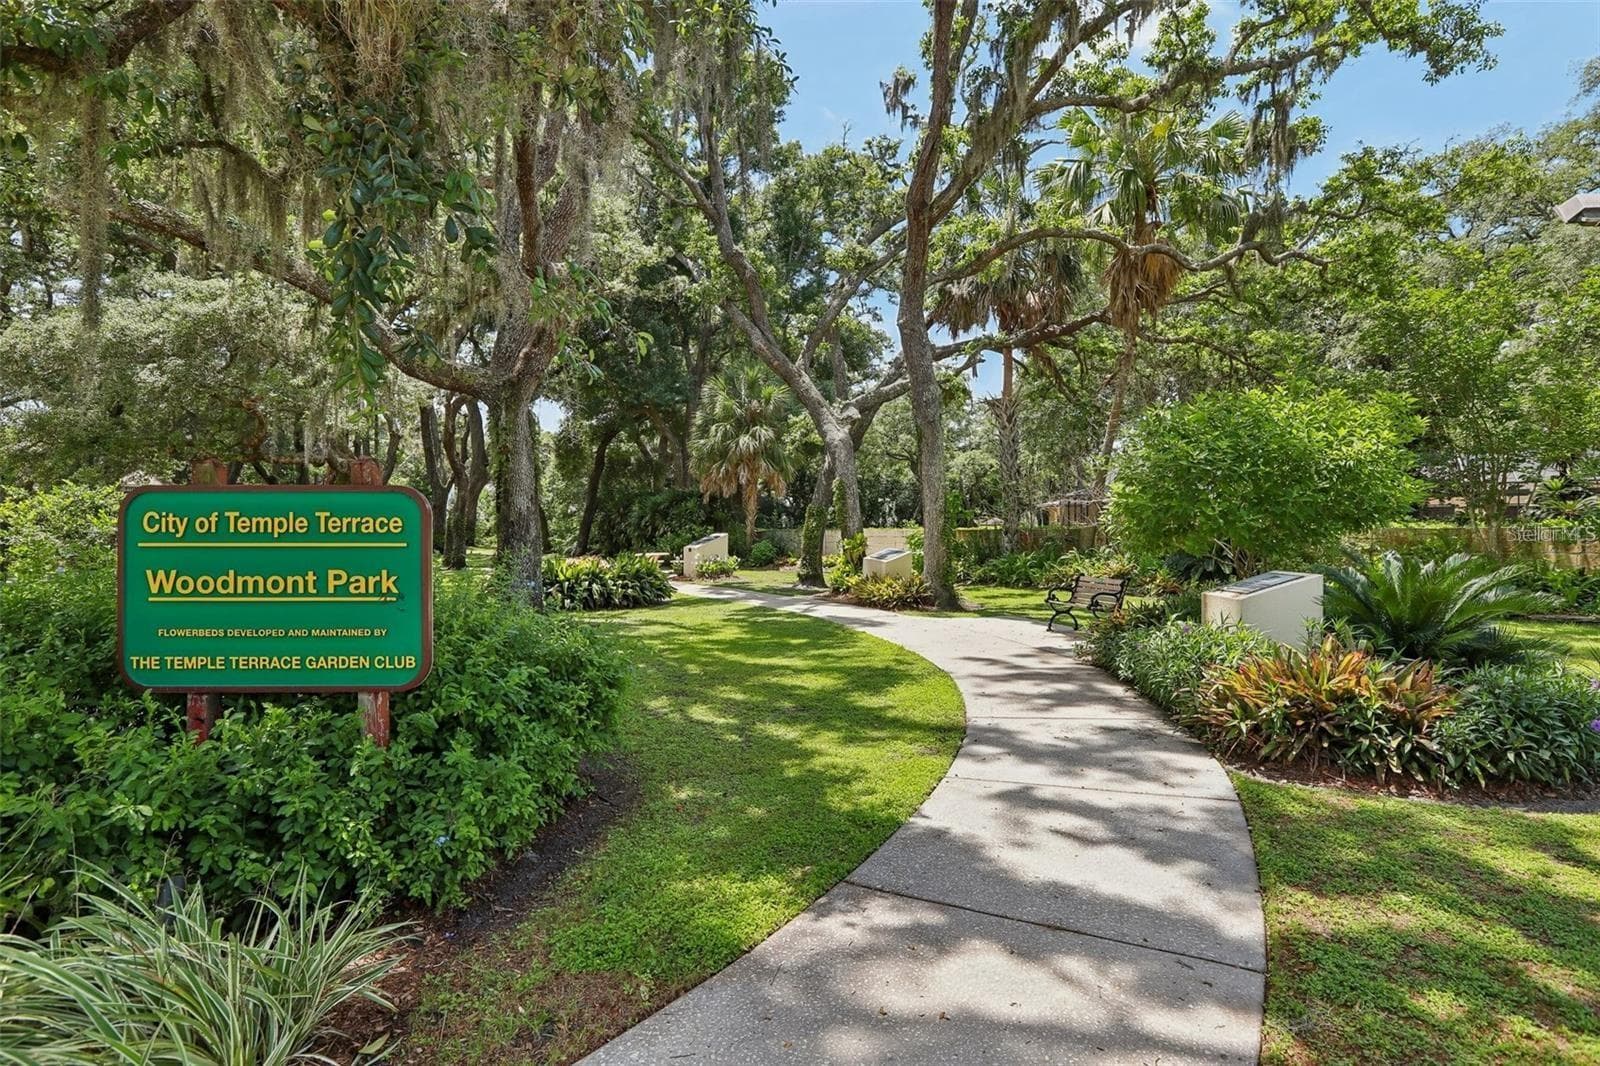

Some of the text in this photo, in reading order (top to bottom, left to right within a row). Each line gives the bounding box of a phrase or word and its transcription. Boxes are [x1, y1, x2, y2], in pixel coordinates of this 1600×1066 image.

[143, 511, 403, 537] City of Temple Terrace
[146, 569, 398, 594] Woodmont Park
[158, 629, 387, 637] FLOWERBEDS DEVELOPED AND MAINTAINED BY
[131, 656, 416, 669] THE TEMPLE TERRACE GARDEN CLUB
